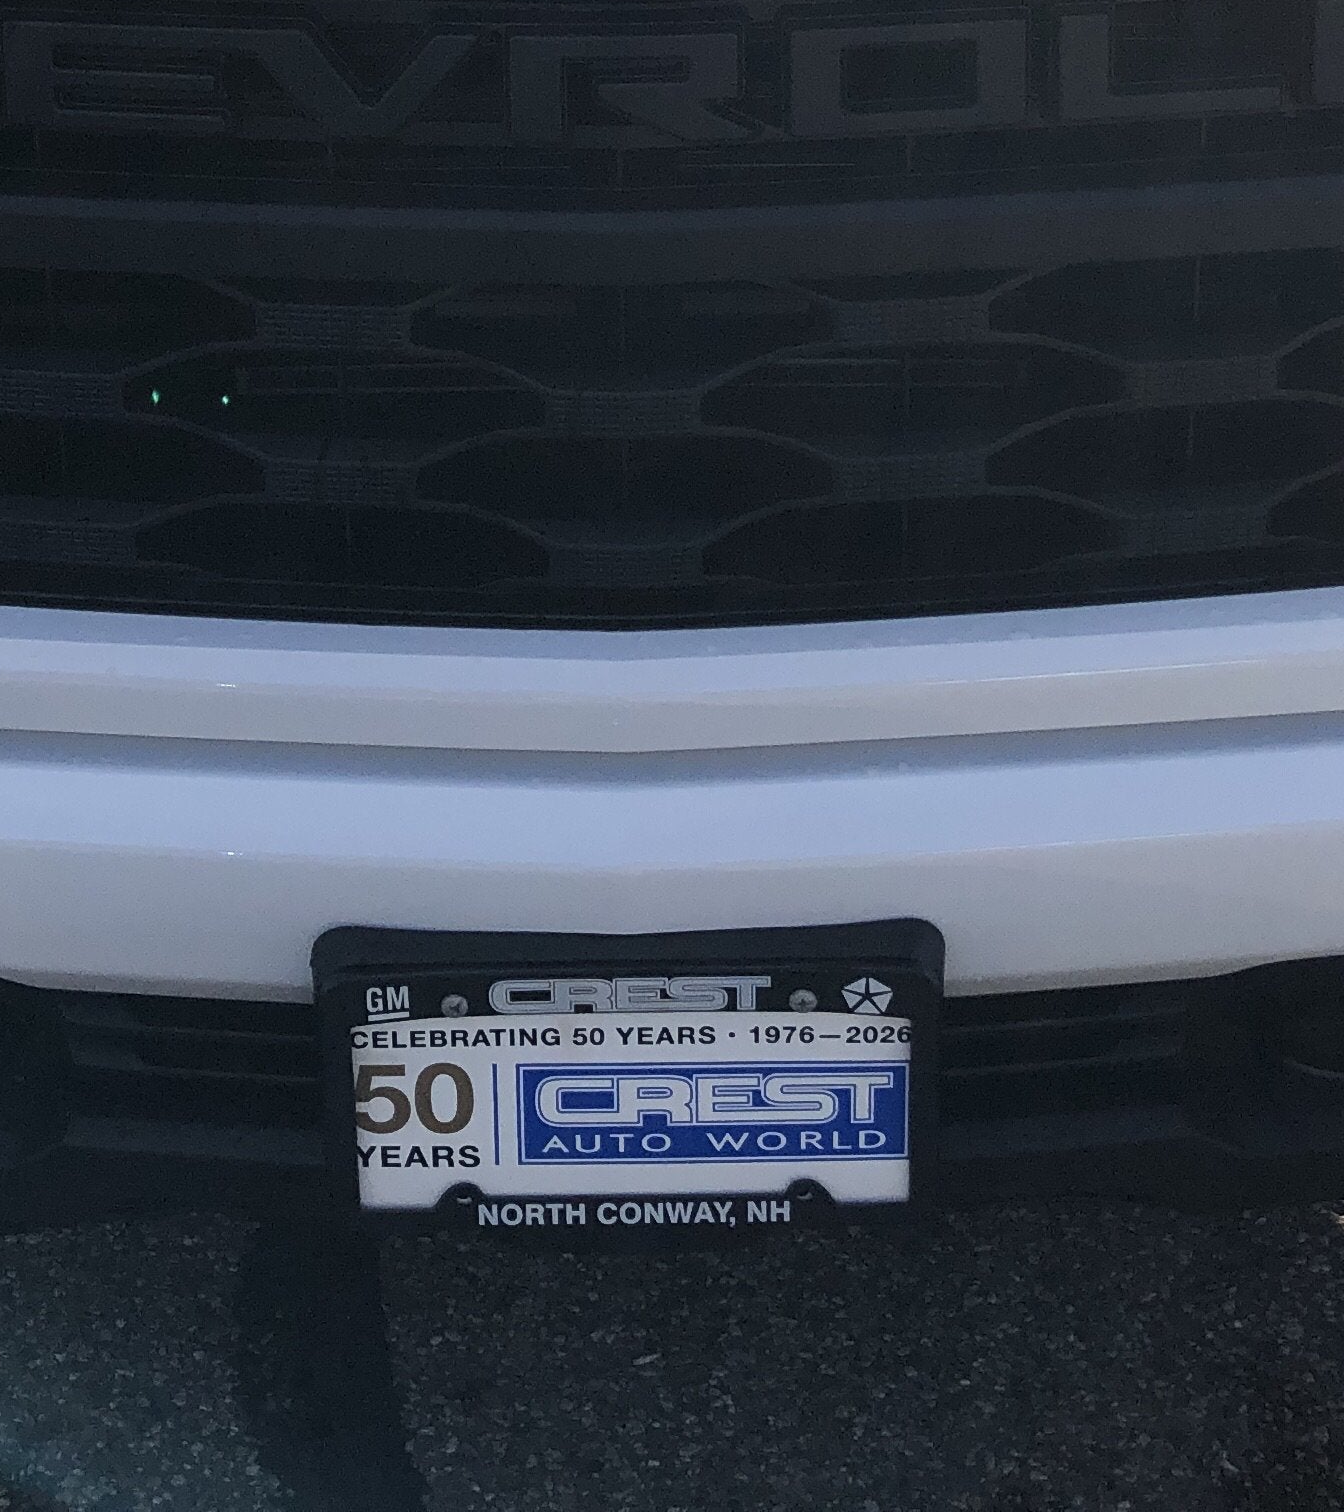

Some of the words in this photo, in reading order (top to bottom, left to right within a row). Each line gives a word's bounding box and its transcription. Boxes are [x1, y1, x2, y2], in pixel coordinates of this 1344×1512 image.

[366, 986, 409, 1013] GM
[489, 976, 771, 1014] CREST
[352, 1027, 560, 1049] CELEBRATING
[572, 1027, 605, 1046] 50
[616, 1026, 716, 1046] YEARS
[356, 1063, 474, 1134] 50
[535, 1072, 894, 1128] CREST
[543, 1133, 671, 1154] AUTO
[706, 1130, 887, 1152] WORLD
[356, 1144, 481, 1168] YEARS
[478, 1203, 586, 1226] NORTH
[596, 1202, 736, 1228] CONWAY,
[747, 1201, 790, 1223] NH
